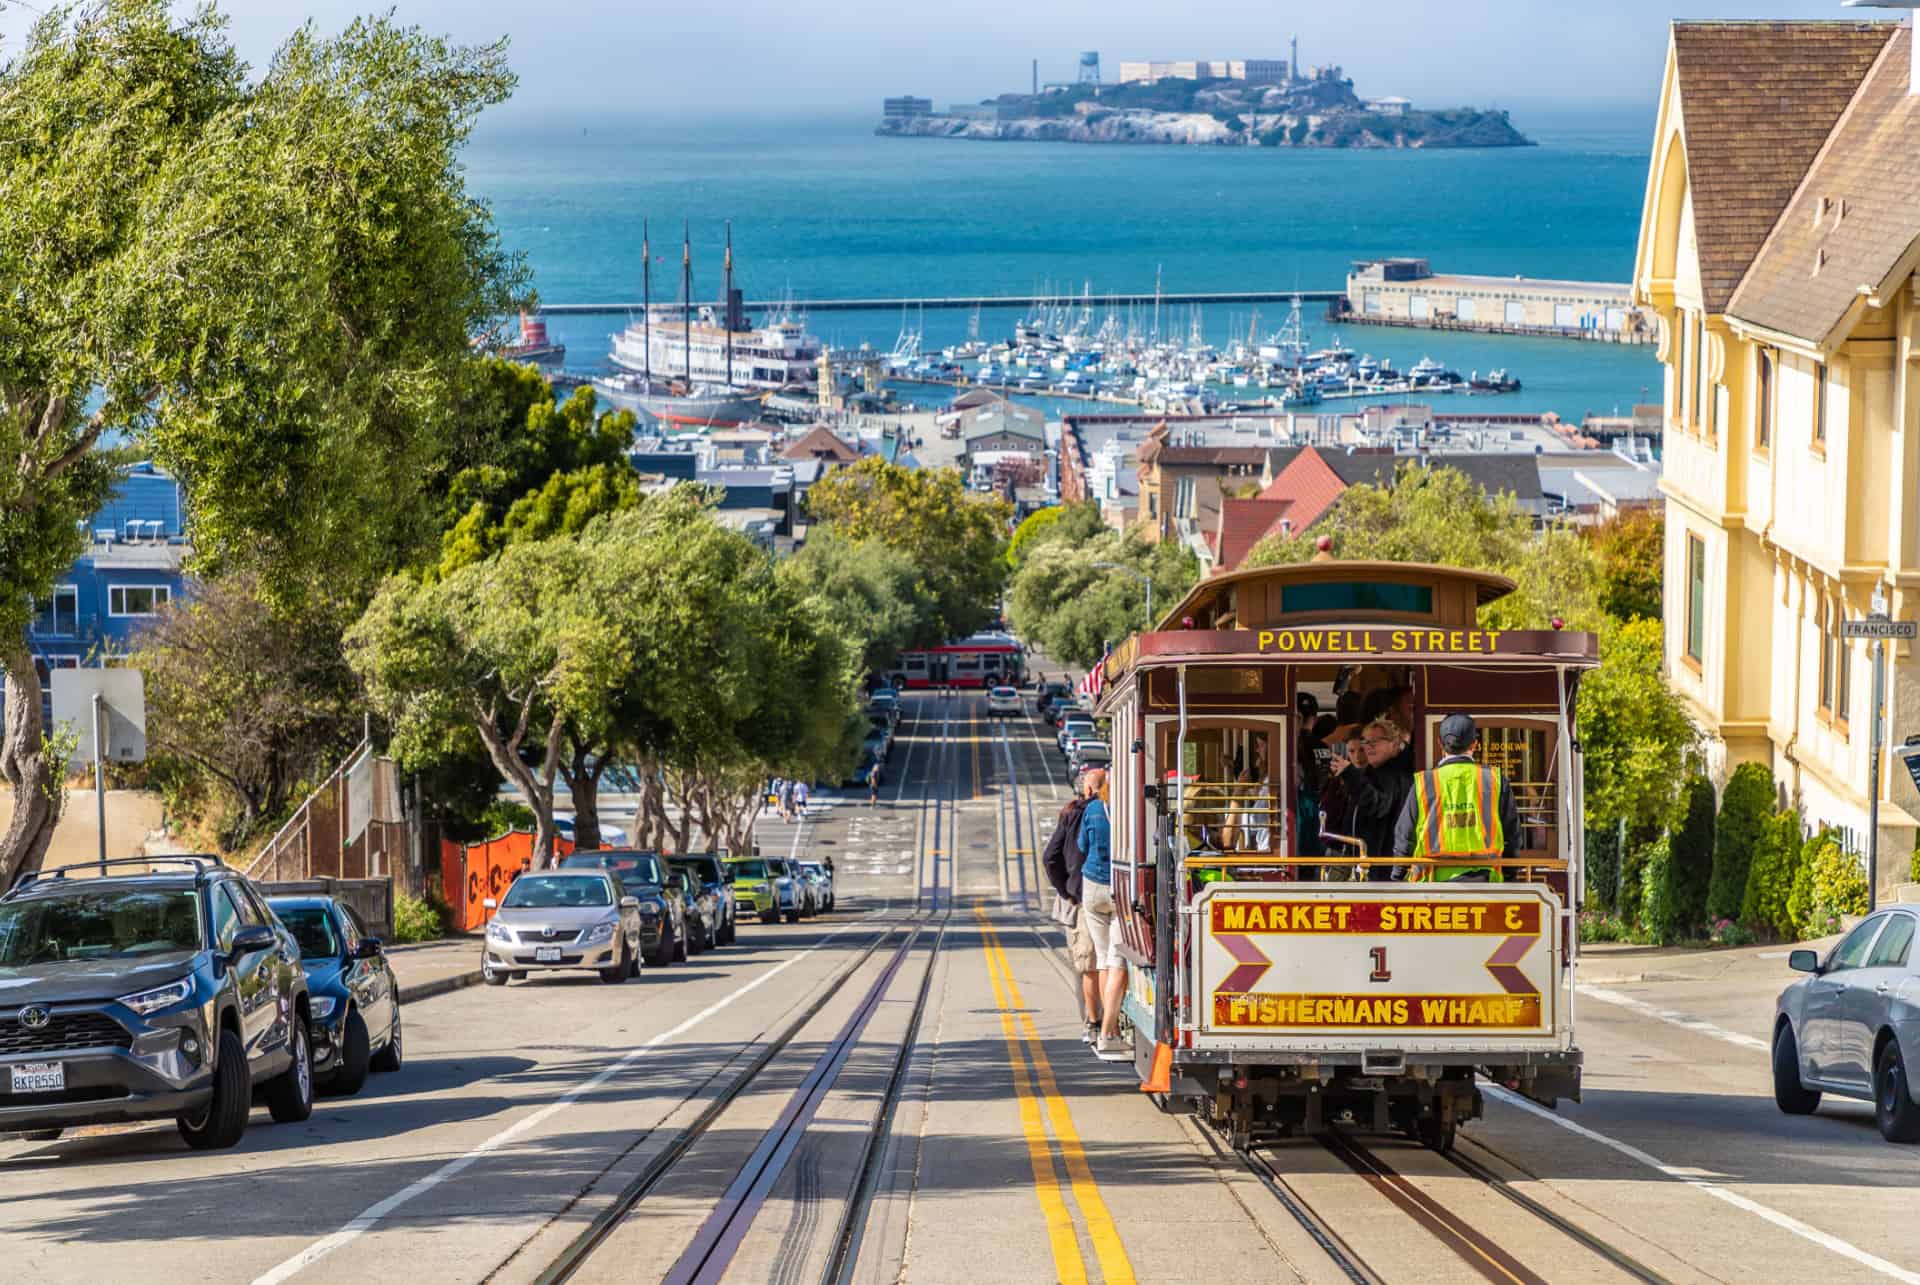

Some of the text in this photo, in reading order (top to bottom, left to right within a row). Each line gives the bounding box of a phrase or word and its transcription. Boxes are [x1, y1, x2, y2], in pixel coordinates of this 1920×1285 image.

[1258, 631, 1501, 651] POWELL STREET
[1847, 624, 1912, 636] FRANCISCO
[1223, 905, 1352, 929] MARKET
[1379, 906, 1488, 931] STREET
[1368, 945, 1392, 983] 1
[1229, 998, 1523, 1024] FISHERMANS WHARF
